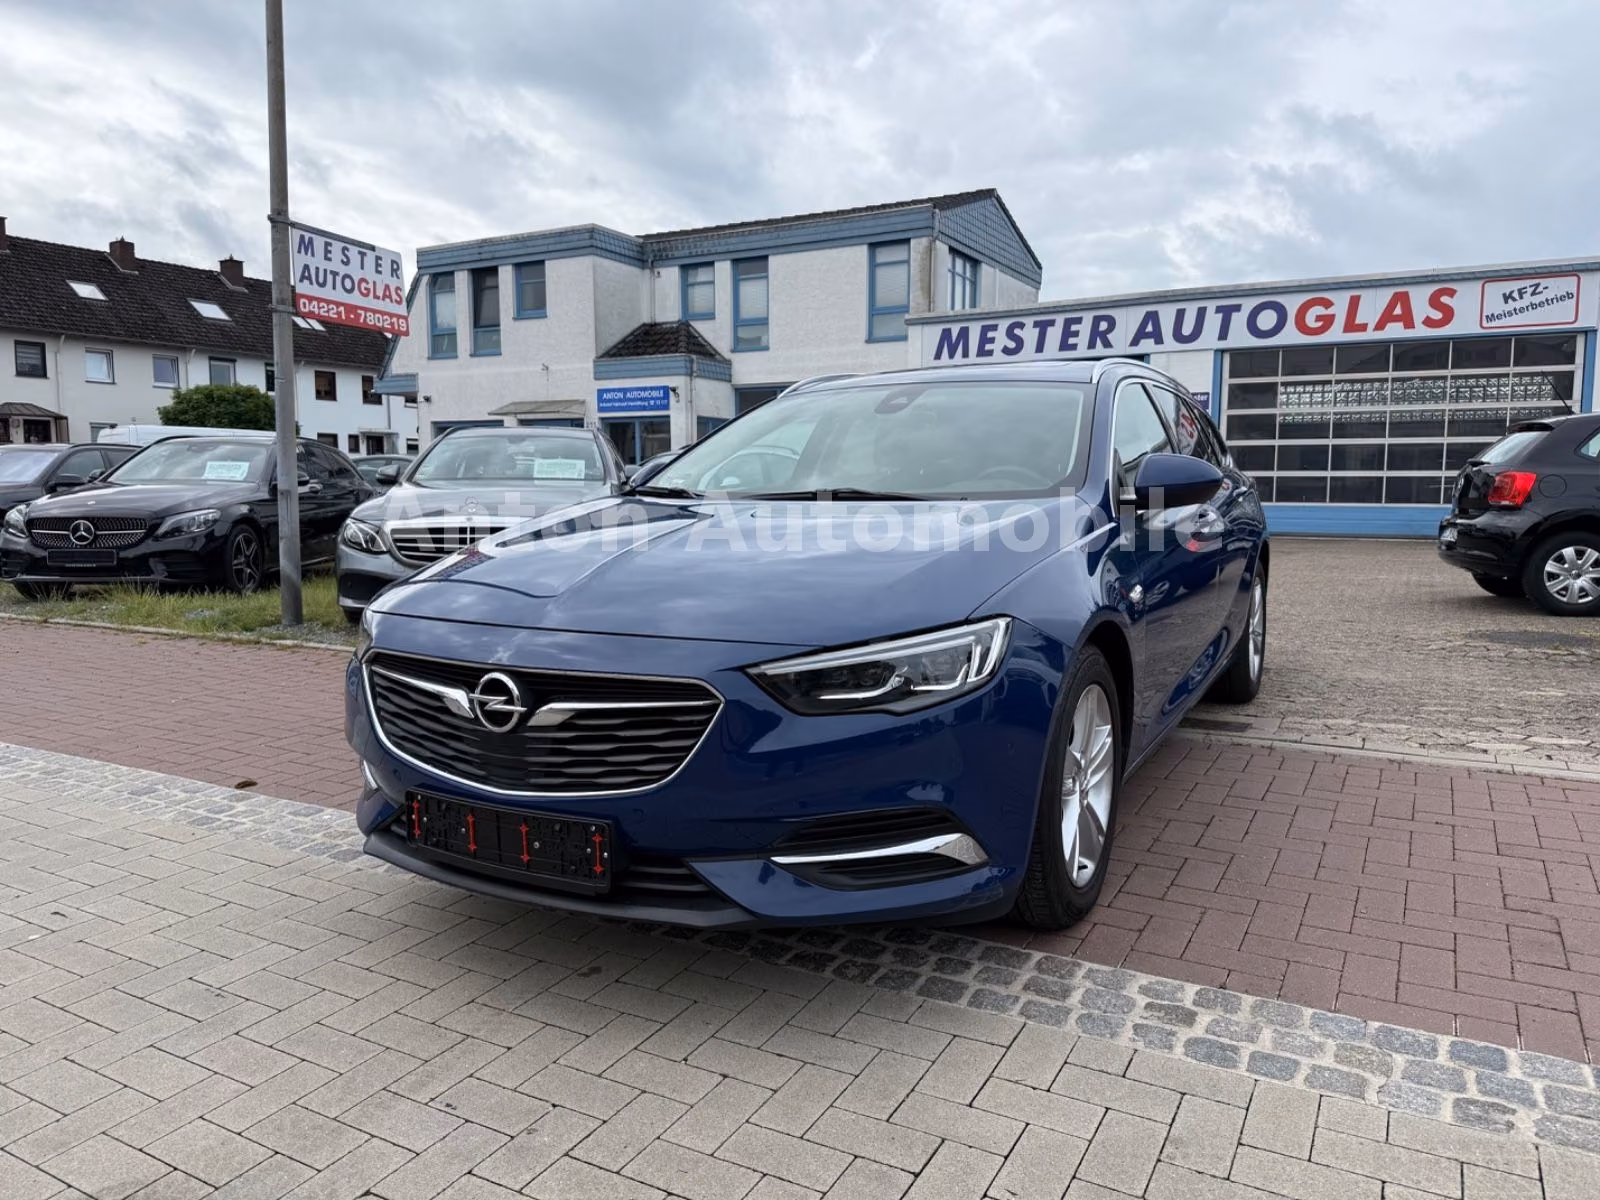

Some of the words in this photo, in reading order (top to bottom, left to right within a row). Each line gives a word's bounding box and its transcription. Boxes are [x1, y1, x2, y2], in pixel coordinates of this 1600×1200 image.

[297, 233, 401, 280] MESTER
[298, 263, 403, 305] AUTOGLAS
[1501, 282, 1549, 304] KFZ-
[299, 298, 346, 320] 04221
[357, 310, 407, 331] 780219
[1484, 290, 1575, 323] Meisterbetrieb
[933, 314, 1117, 360] MESTER
[1129, 287, 1458, 347] AUTOGLAS
[602, 391, 624, 400] ANTON
[626, 389, 664, 399] AUTOMOBILE
